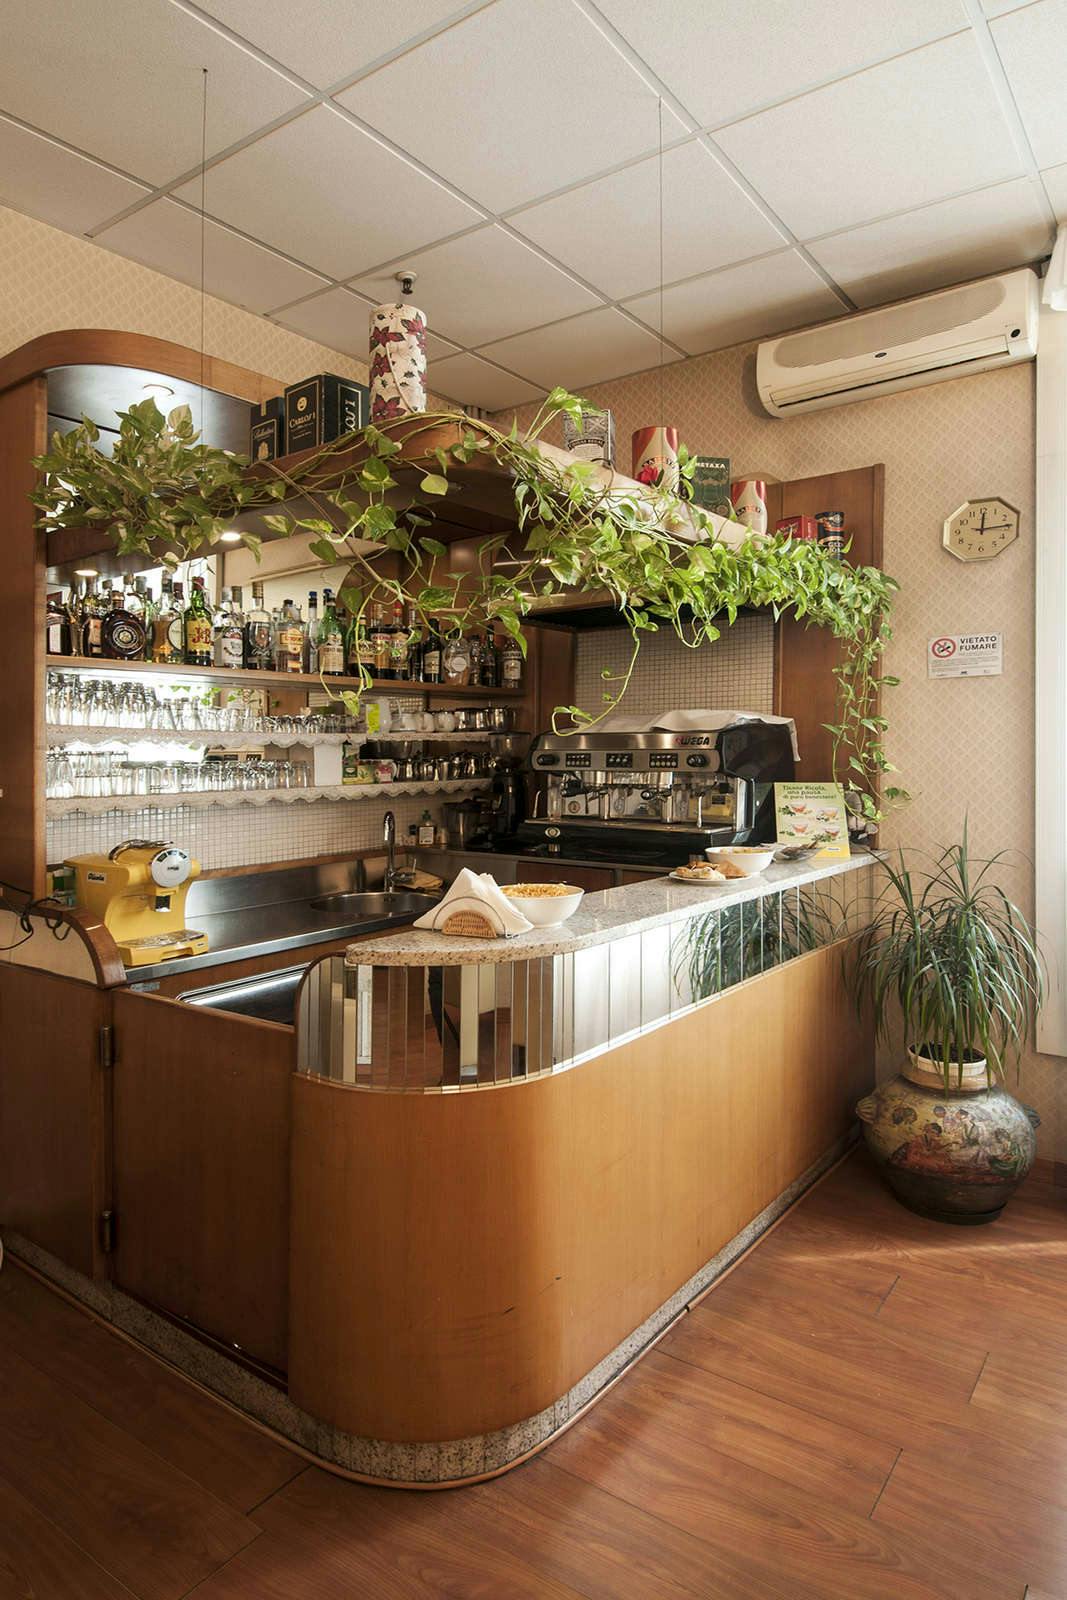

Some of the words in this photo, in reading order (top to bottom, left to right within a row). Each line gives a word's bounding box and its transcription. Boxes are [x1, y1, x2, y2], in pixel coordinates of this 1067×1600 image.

[959, 518, 969, 526] 10
[978, 544, 985, 552] 6
[960, 635, 997, 644] VIETATO
[959, 643, 997, 651] FUMARE
[681, 736, 710, 745] WEGA
